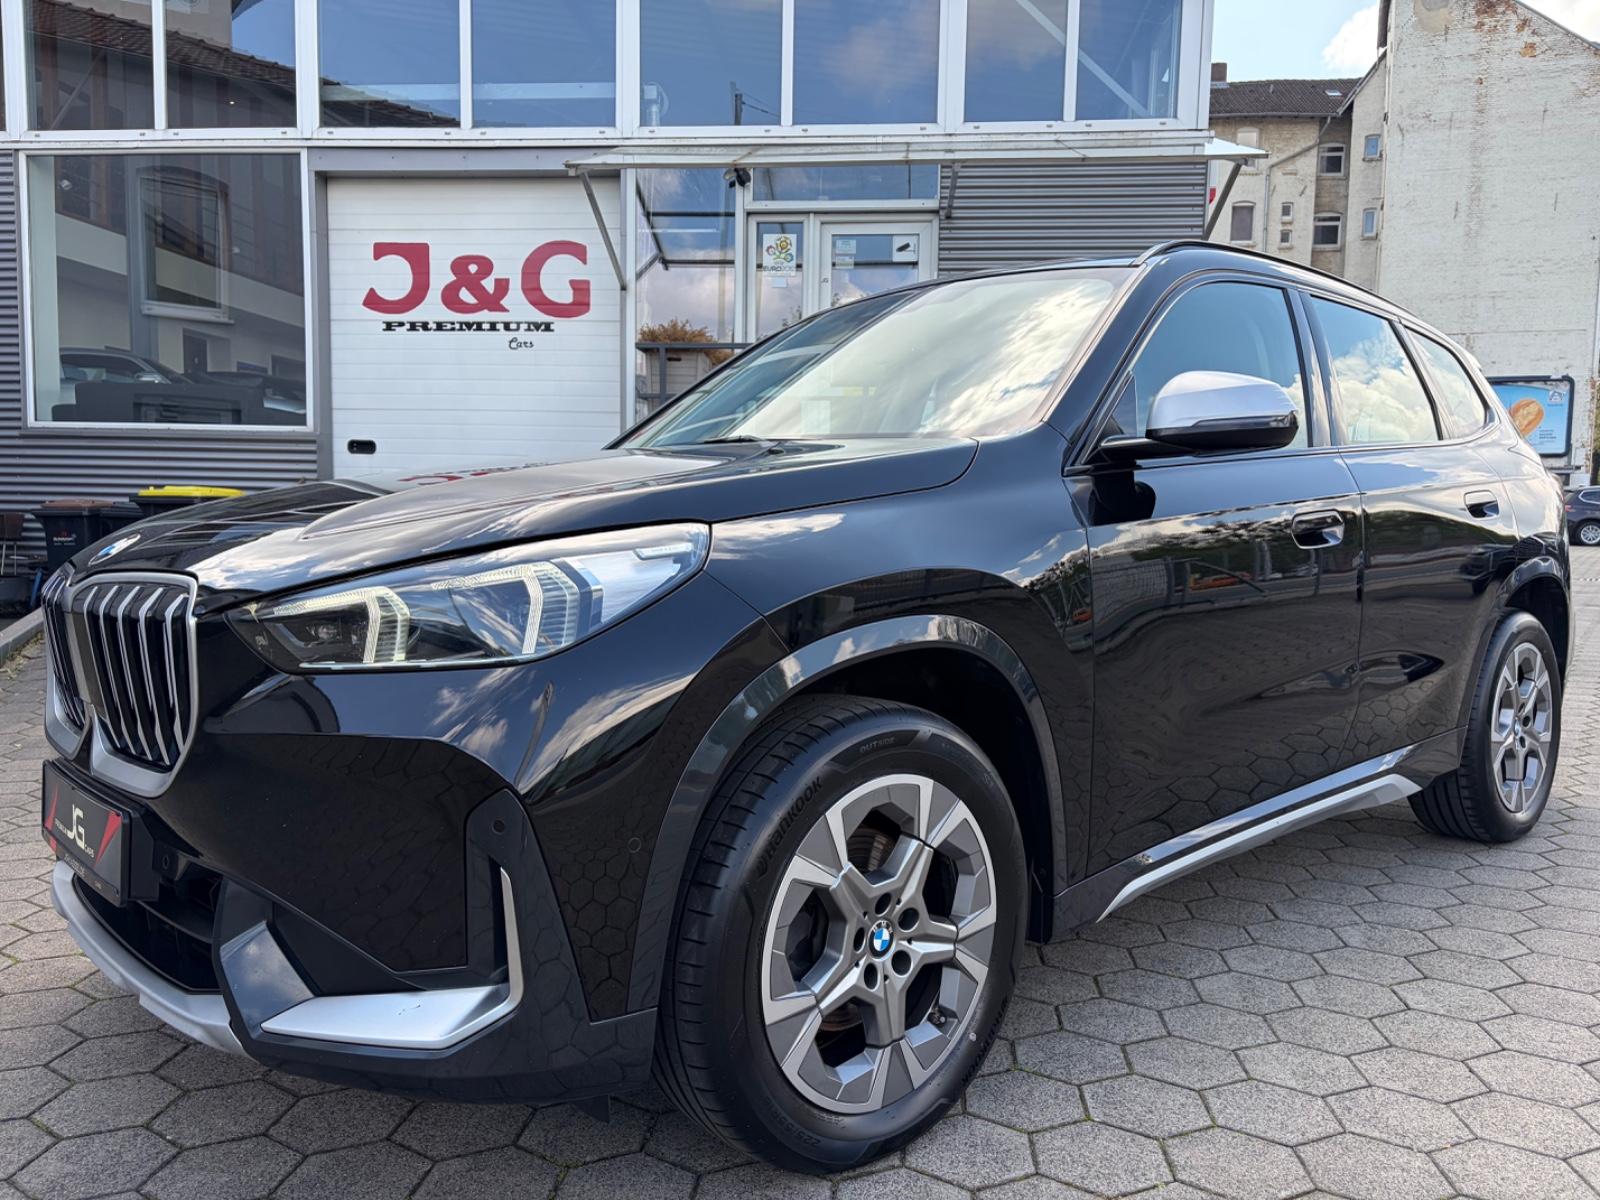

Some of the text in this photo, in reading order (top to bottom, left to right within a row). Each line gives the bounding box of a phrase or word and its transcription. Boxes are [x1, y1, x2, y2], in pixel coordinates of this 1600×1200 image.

[362, 240, 591, 318] J&G
[382, 321, 554, 332] PREMIUM
[508, 337, 534, 350] Cars
[860, 737, 895, 753] OUTSIDE
